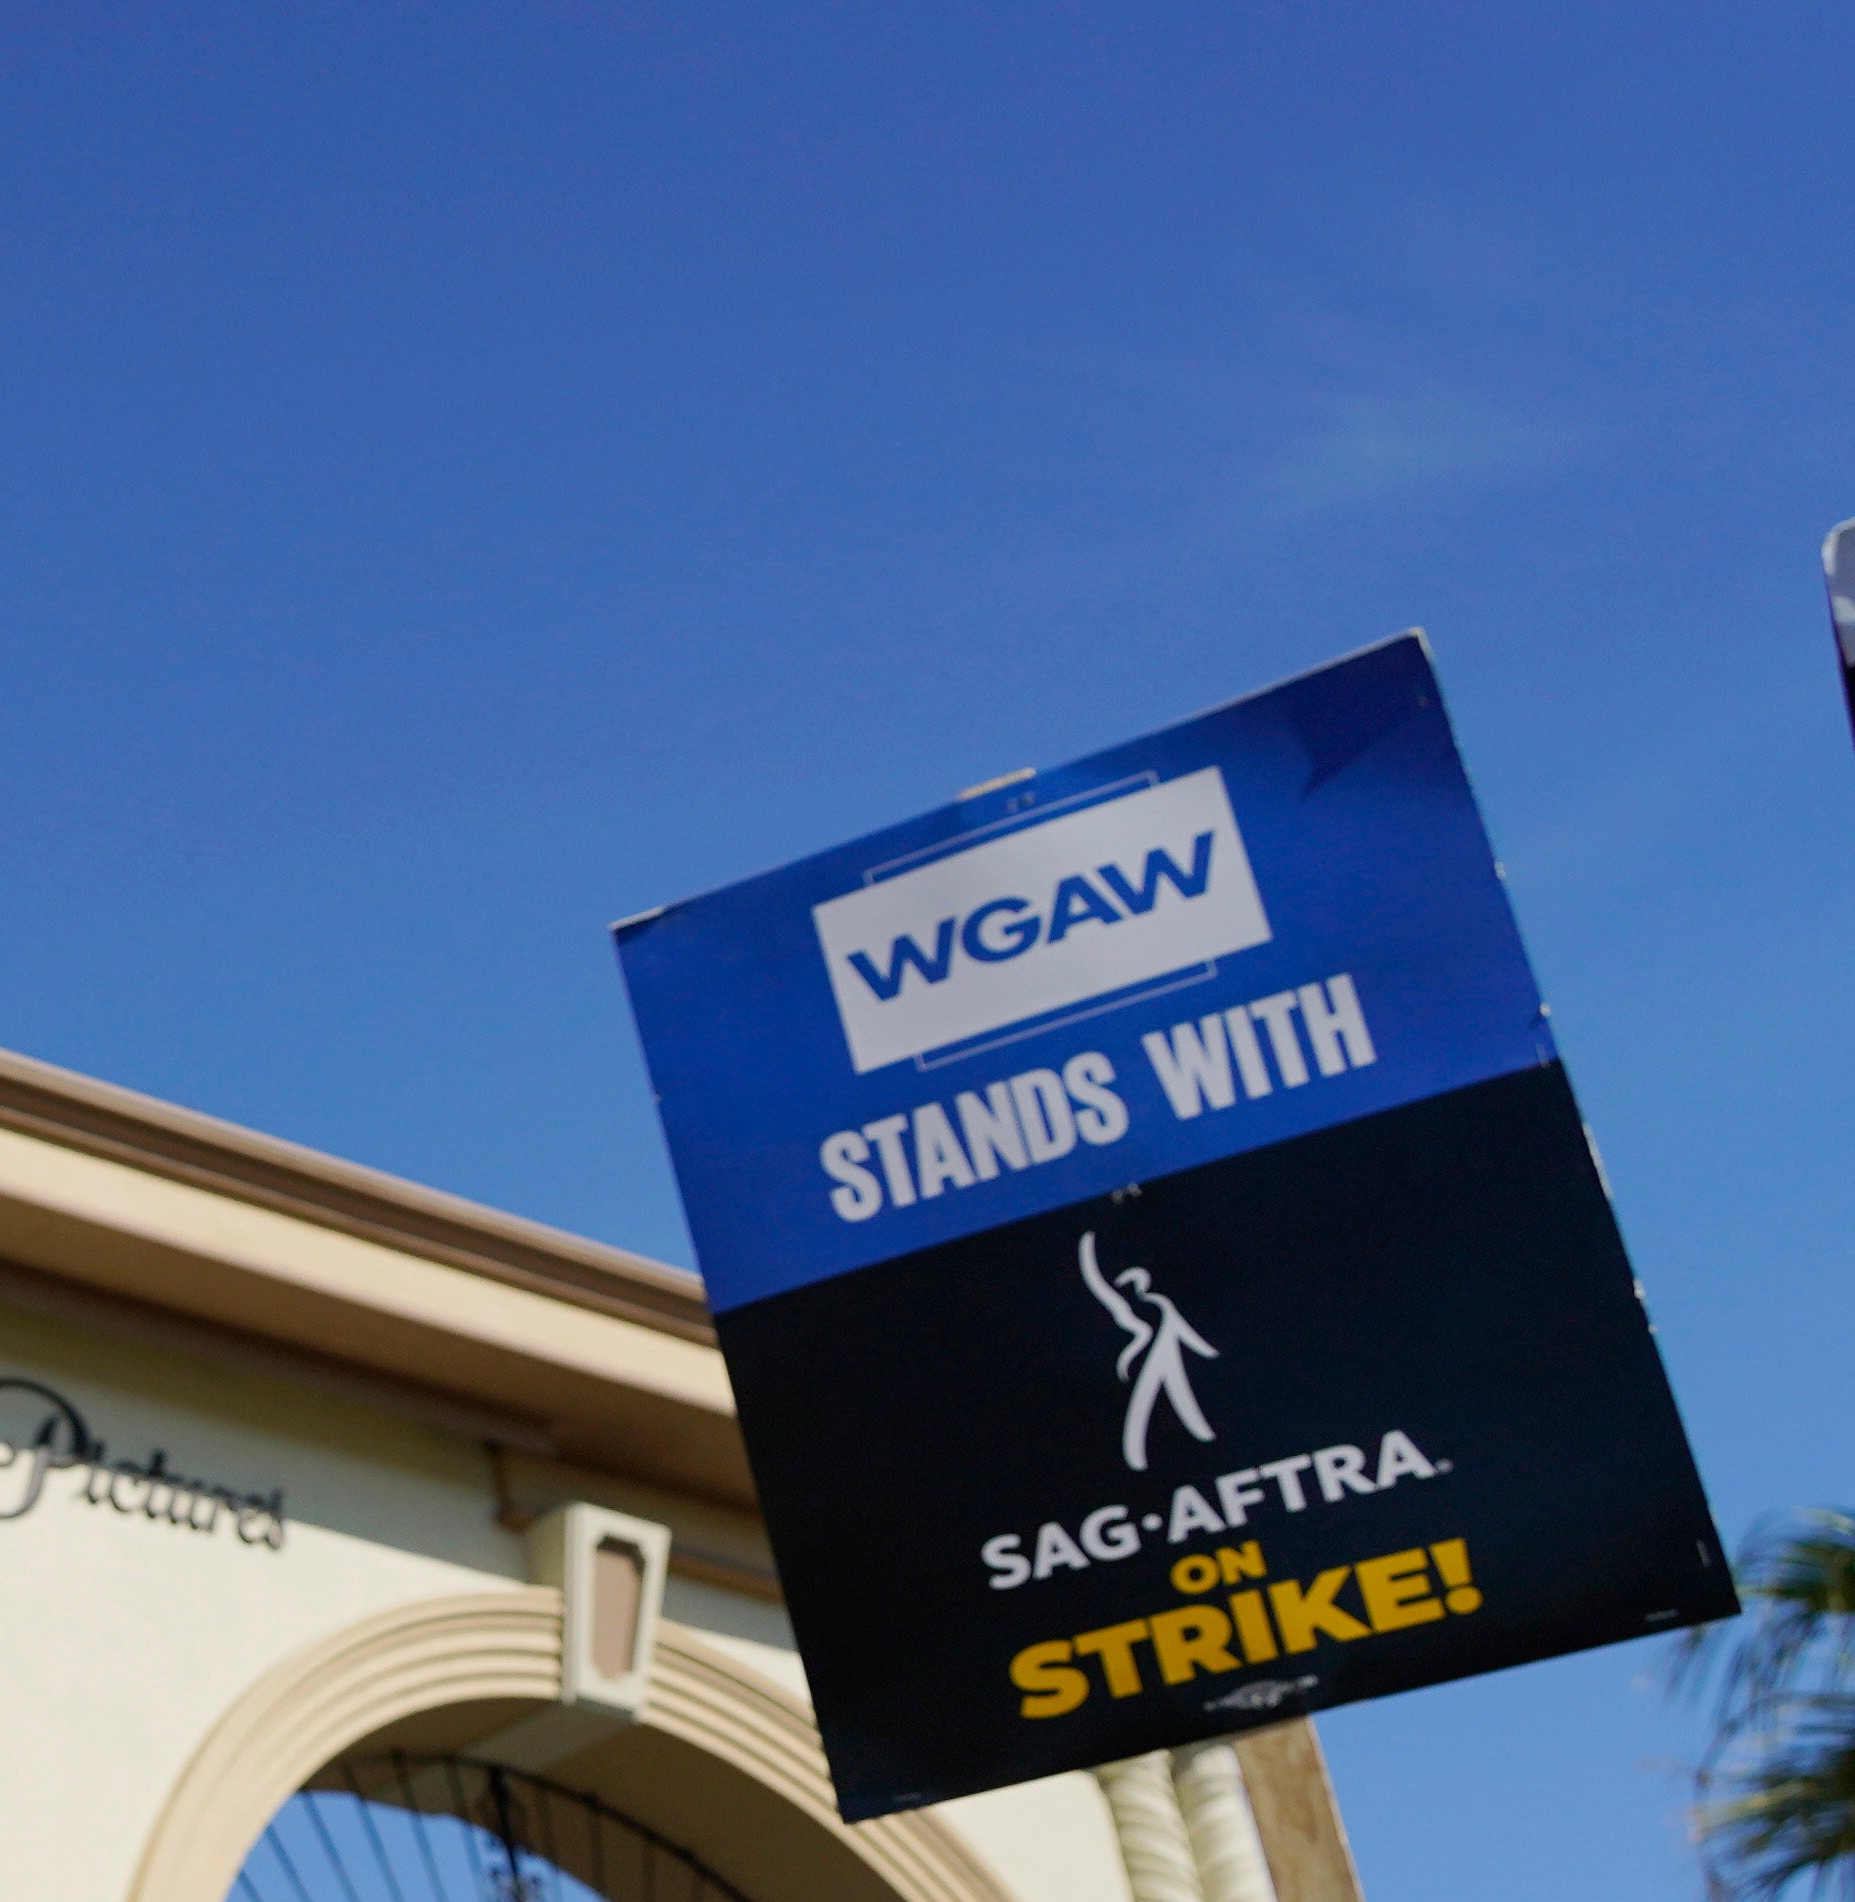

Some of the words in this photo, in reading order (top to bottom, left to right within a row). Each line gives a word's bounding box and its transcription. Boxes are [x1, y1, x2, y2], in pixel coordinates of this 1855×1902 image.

[847, 829, 1214, 1002] WGAW
[820, 1051, 1130, 1223] STANDS
[1141, 973, 1376, 1120] WITH
[1009, 1538, 1484, 1719] STRIKE!
[1171, 1540, 1266, 1593] ON
